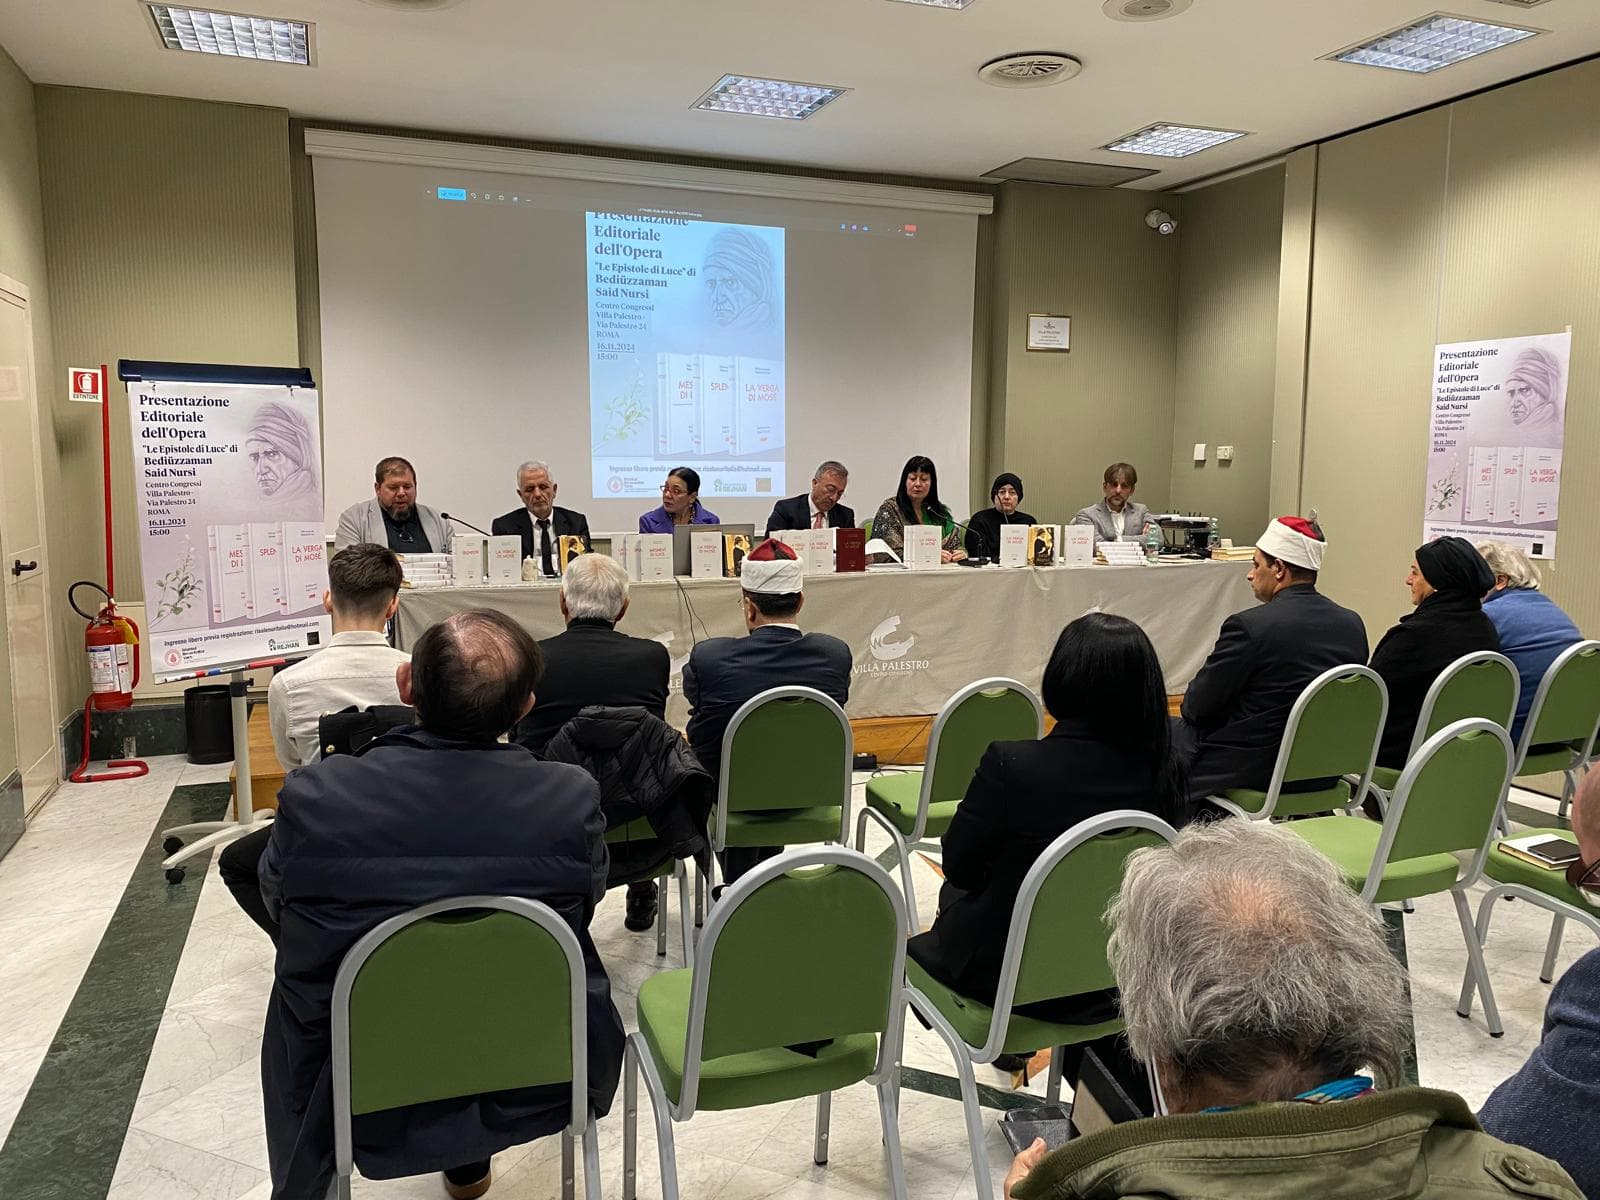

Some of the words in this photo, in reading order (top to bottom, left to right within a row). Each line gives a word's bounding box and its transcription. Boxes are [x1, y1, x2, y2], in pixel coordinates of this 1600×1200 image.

[594, 226, 661, 241] Editoriale
[594, 243, 662, 259] dell'Opera
[612, 263, 649, 273] Epistole
[650, 265, 659, 274] di
[687, 268, 696, 276] di
[595, 274, 667, 287] Bediüzzaman
[595, 288, 619, 297] Said
[621, 289, 649, 299] Nursi
[596, 301, 620, 309] Centro
[1440, 348, 1498, 360] Presentazione
[1439, 361, 1479, 371] Editoriale
[1438, 374, 1479, 384] dell'Opera
[745, 384, 756, 392] LA
[757, 384, 779, 392] VERGA
[139, 394, 230, 407] Presentazione
[141, 410, 204, 422] Editoriale
[142, 427, 206, 441] dell'Opera
[160, 445, 194, 454] Epistole
[144, 456, 212, 465] Bediüzzaman
[145, 469, 167, 477] Said
[169, 468, 196, 477] Nursi
[303, 545, 323, 553] VERGA
[853, 663, 879, 674] VILLA
[882, 660, 929, 671] PALESTRO
